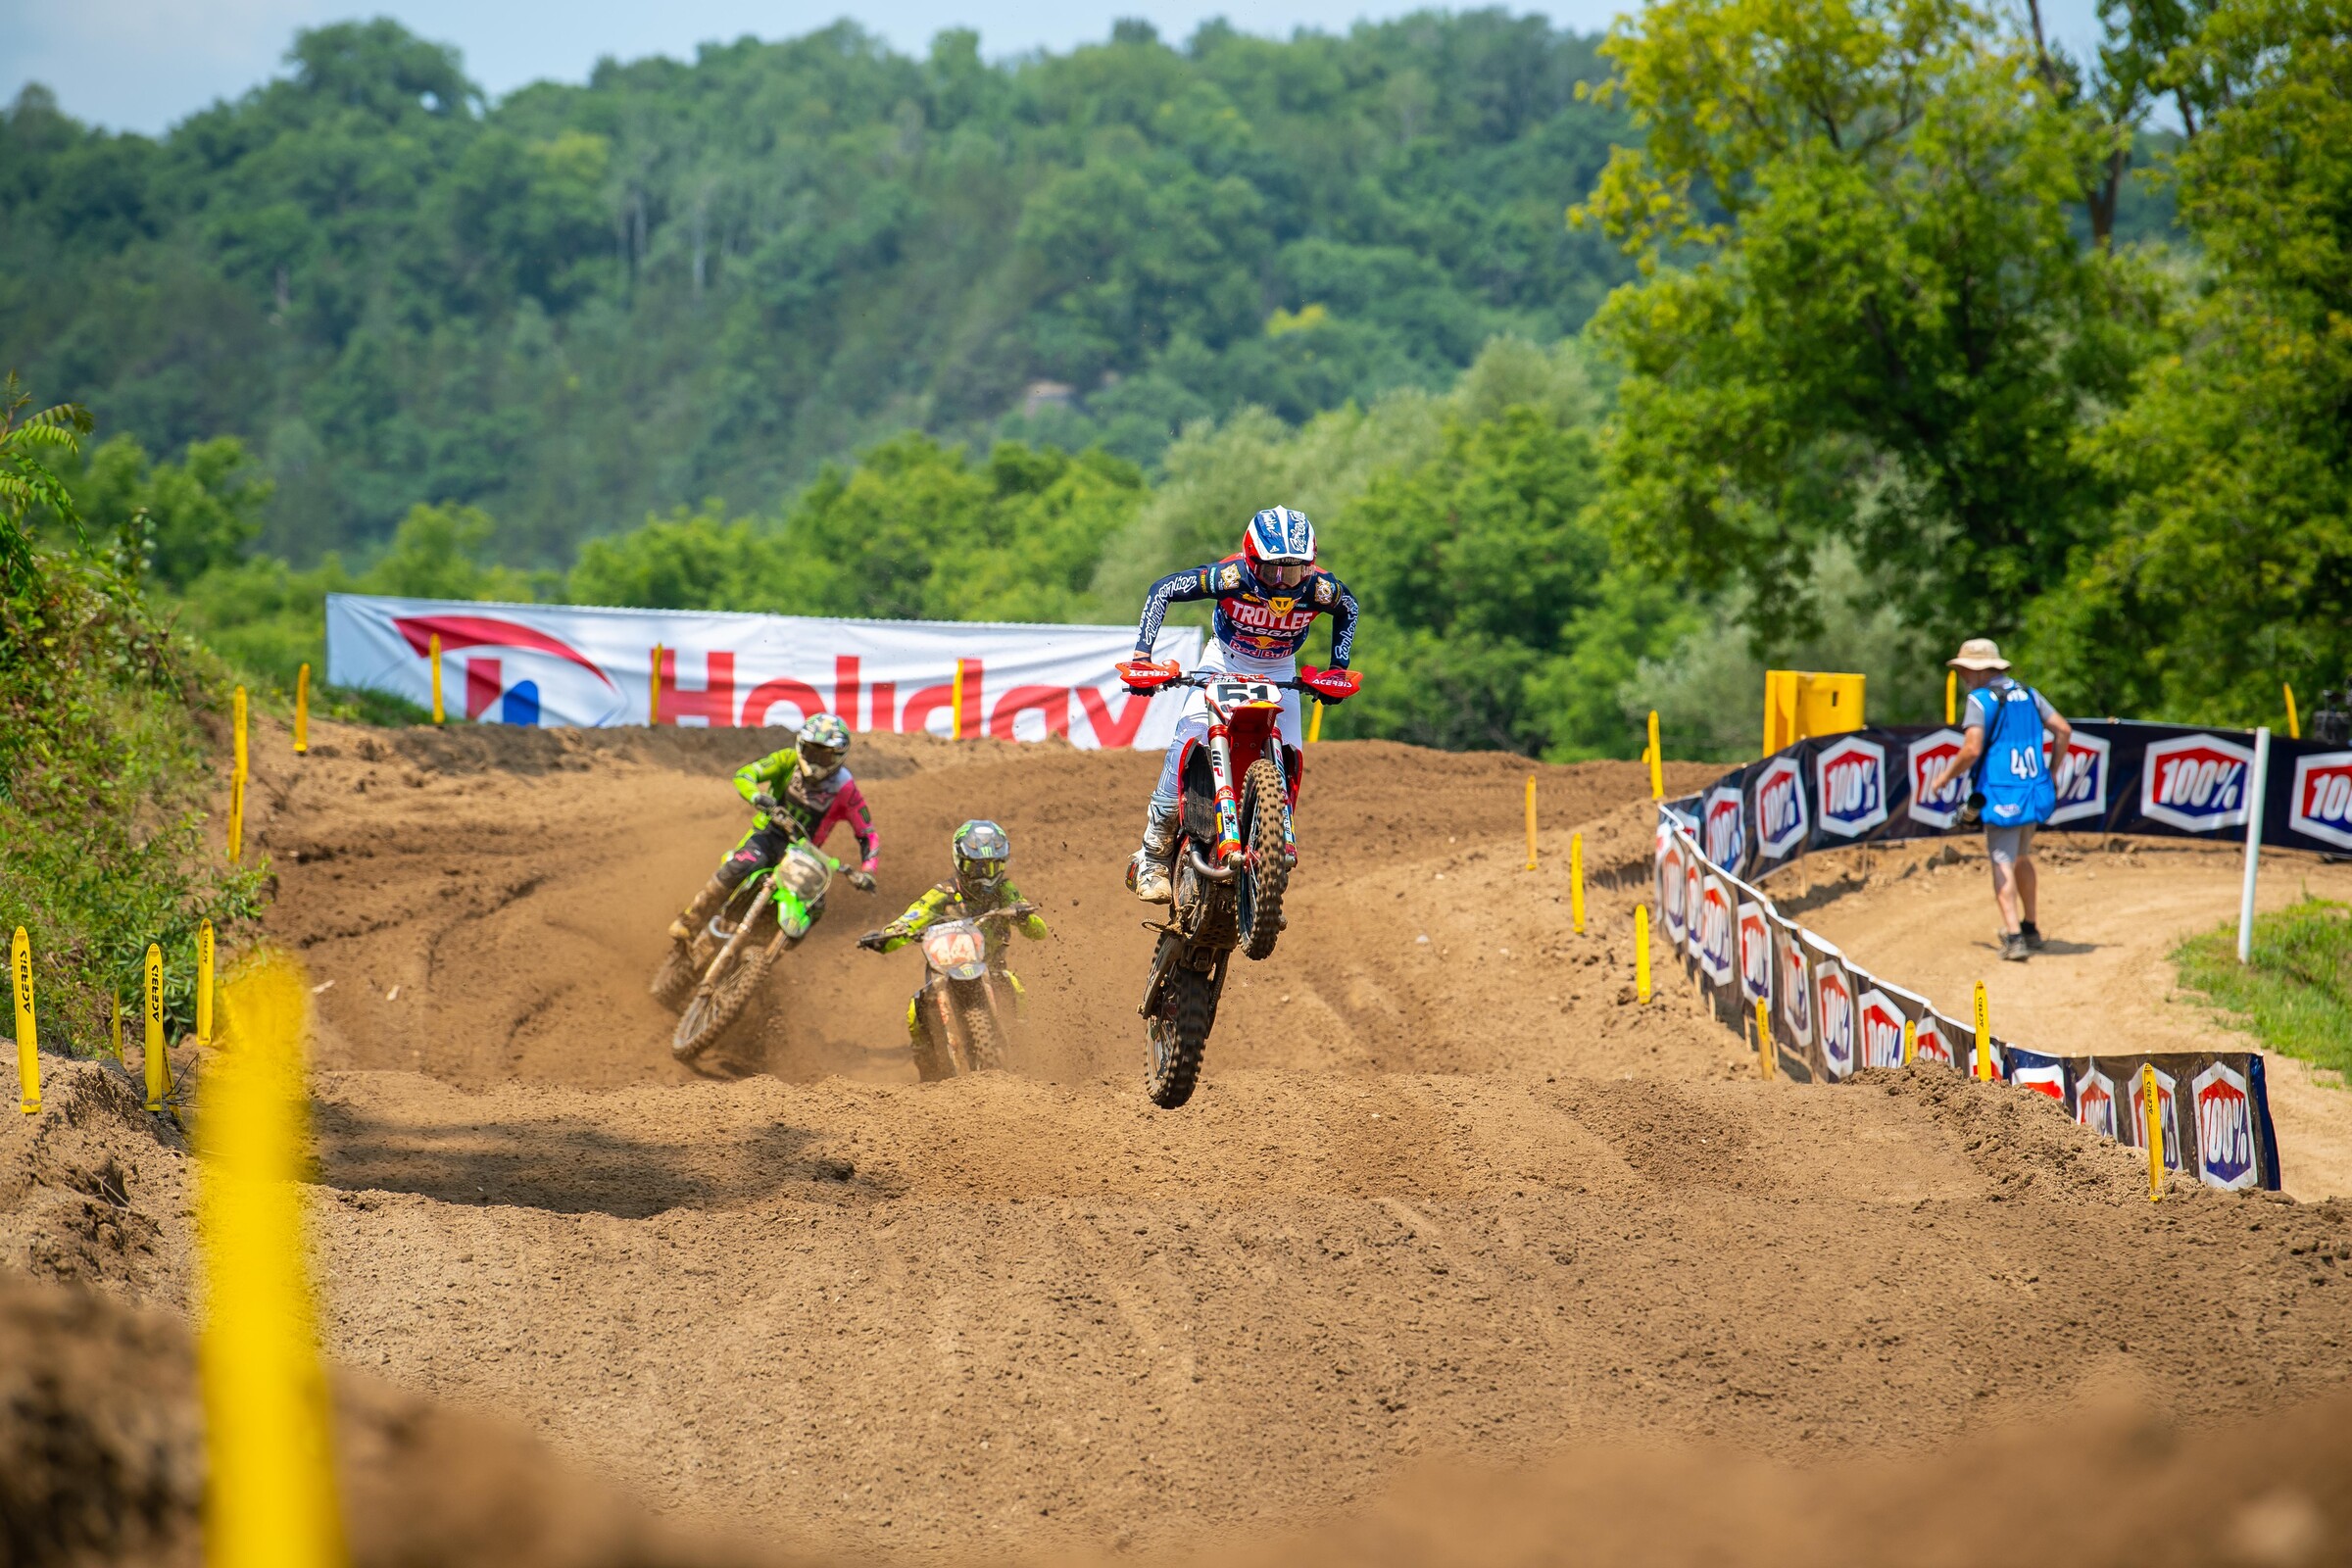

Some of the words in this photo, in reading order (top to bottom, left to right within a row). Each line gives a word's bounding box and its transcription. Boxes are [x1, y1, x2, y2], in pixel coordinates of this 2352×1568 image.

[1279, 612, 1313, 630] LEE
[1229, 639, 1261, 658] Red
[1260, 648, 1293, 659] Bull
[651, 648, 1156, 749] Holiday
[1216, 683, 1269, 712] 51
[2010, 746, 2038, 780] 40
[2159, 758, 2243, 809] 100%
[2202, 1097, 2247, 1164] 100%
